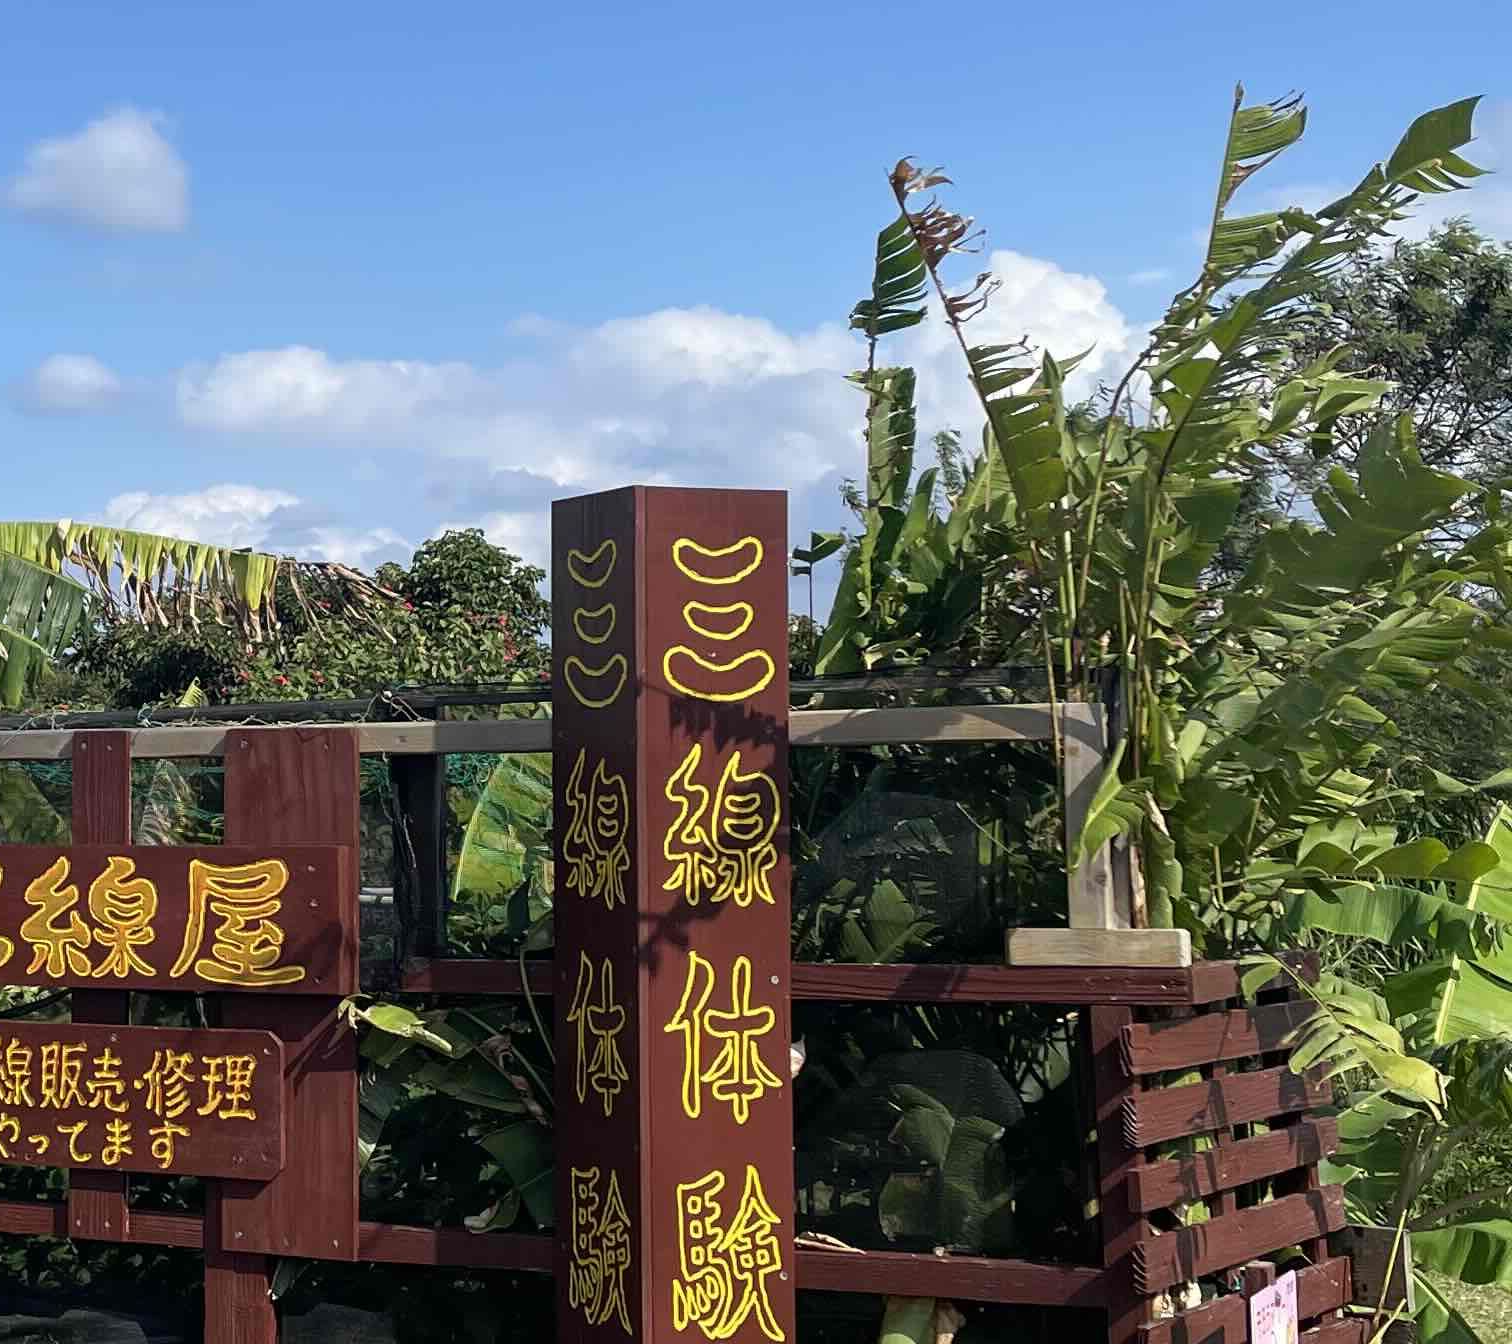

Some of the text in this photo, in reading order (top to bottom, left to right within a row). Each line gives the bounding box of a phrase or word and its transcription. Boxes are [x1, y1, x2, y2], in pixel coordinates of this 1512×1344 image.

[565, 538, 633, 1337] 三線体験
[663, 535, 785, 1343] 三線体験
